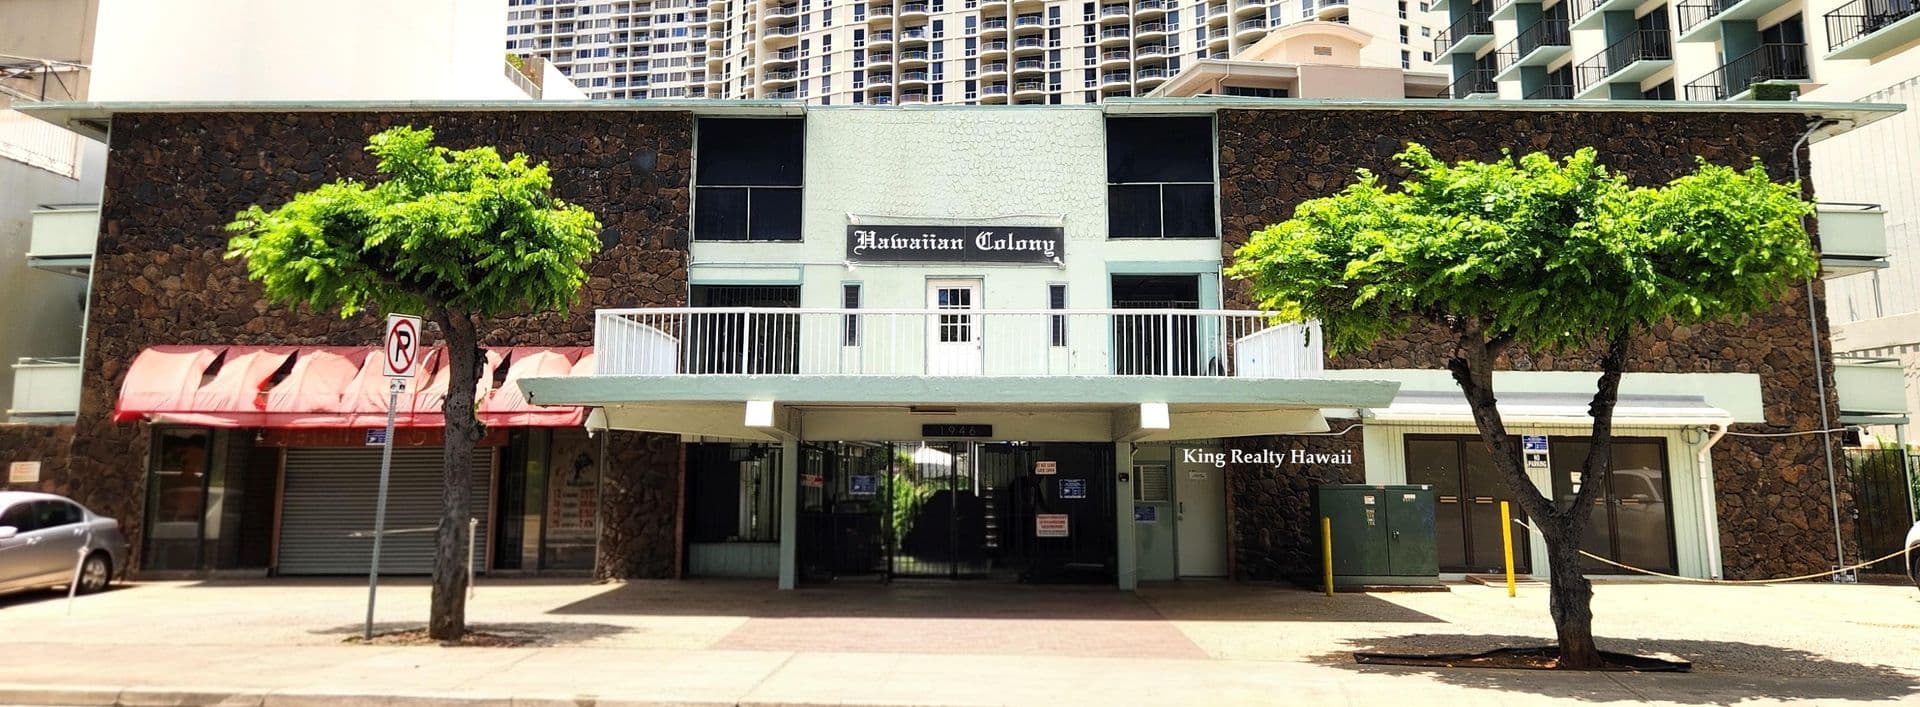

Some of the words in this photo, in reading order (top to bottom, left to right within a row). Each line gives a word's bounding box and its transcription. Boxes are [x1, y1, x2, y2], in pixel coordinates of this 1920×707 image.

[854, 230, 964, 255] Hawaiian
[975, 231, 1056, 257] Colony
[395, 330, 411, 362] P
[940, 426, 976, 436] 1946
